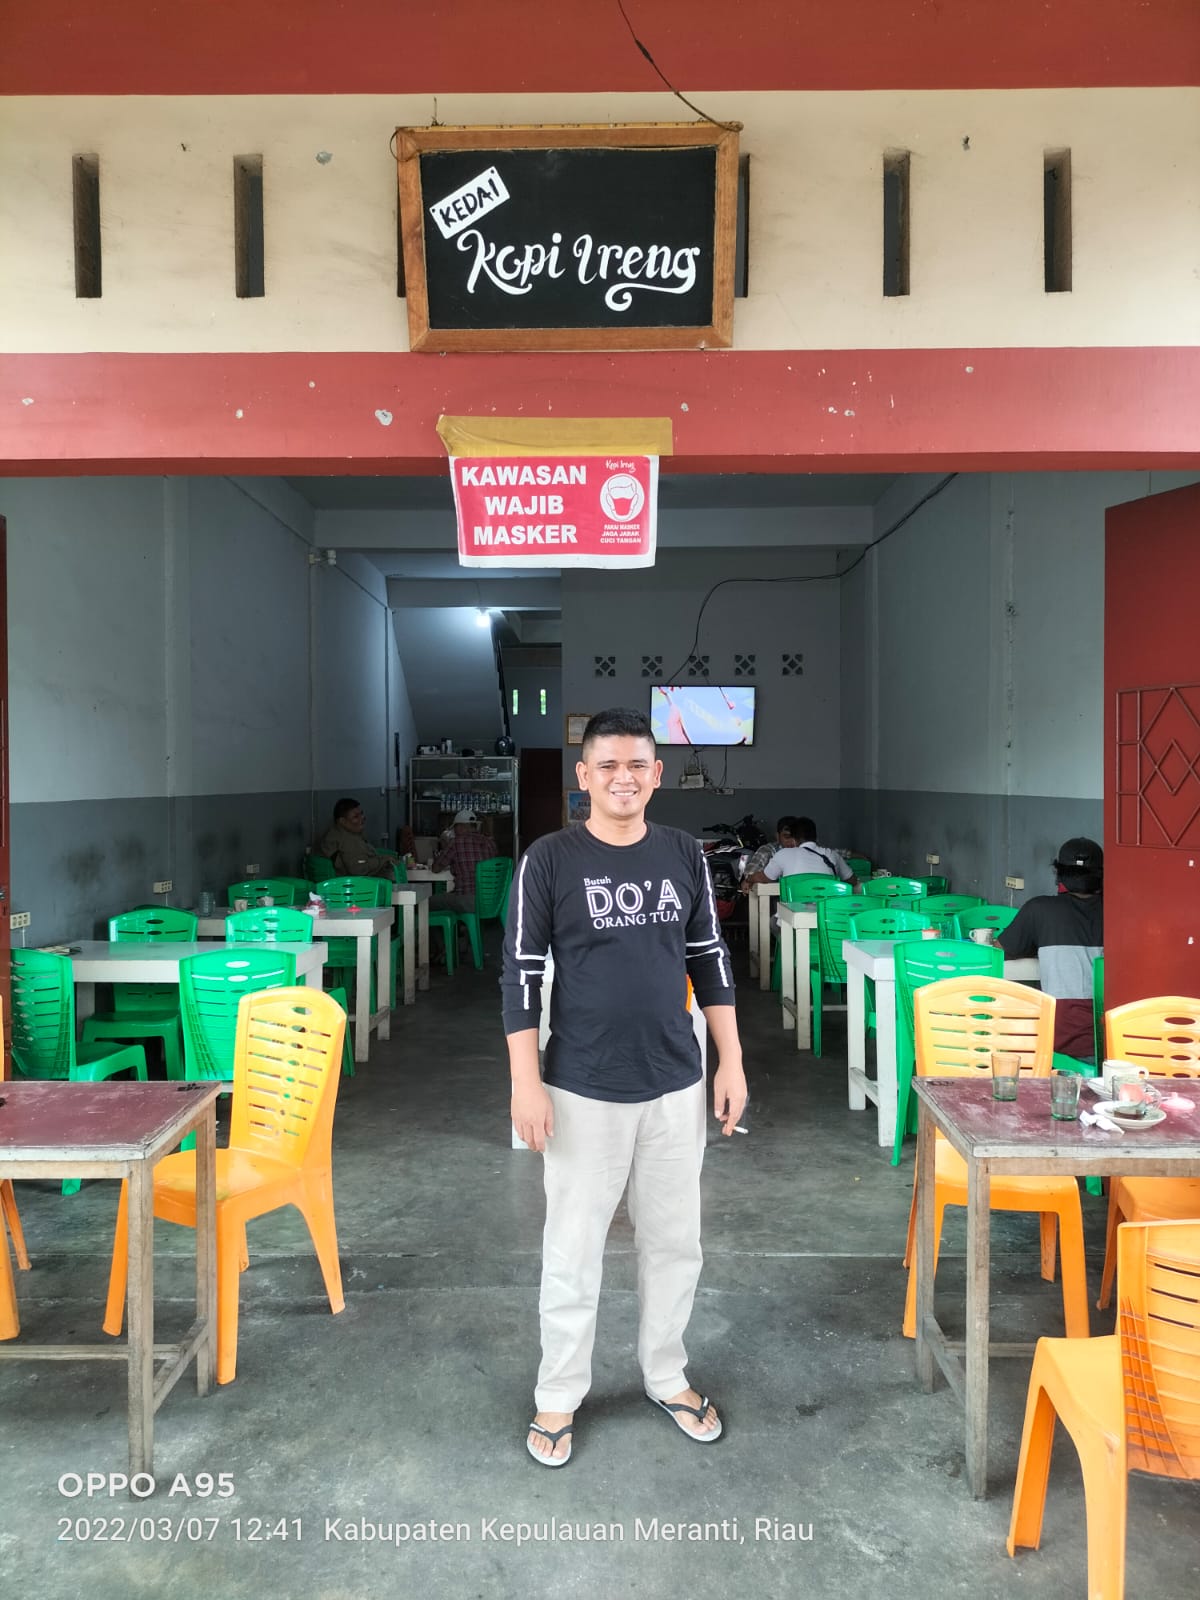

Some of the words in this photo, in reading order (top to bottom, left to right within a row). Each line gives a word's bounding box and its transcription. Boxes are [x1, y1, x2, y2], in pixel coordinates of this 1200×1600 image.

[438, 178, 500, 228] KEDAI
[457, 229, 565, 295] Kopi
[573, 234, 701, 311] Ireng
[461, 465, 587, 487] KAWASAN
[484, 495, 564, 515] WAJIB
[473, 524, 578, 546] MASKER
[583, 876, 612, 887] Butuh
[593, 913, 647, 930] ORANG
[649, 910, 680, 923] TUA
